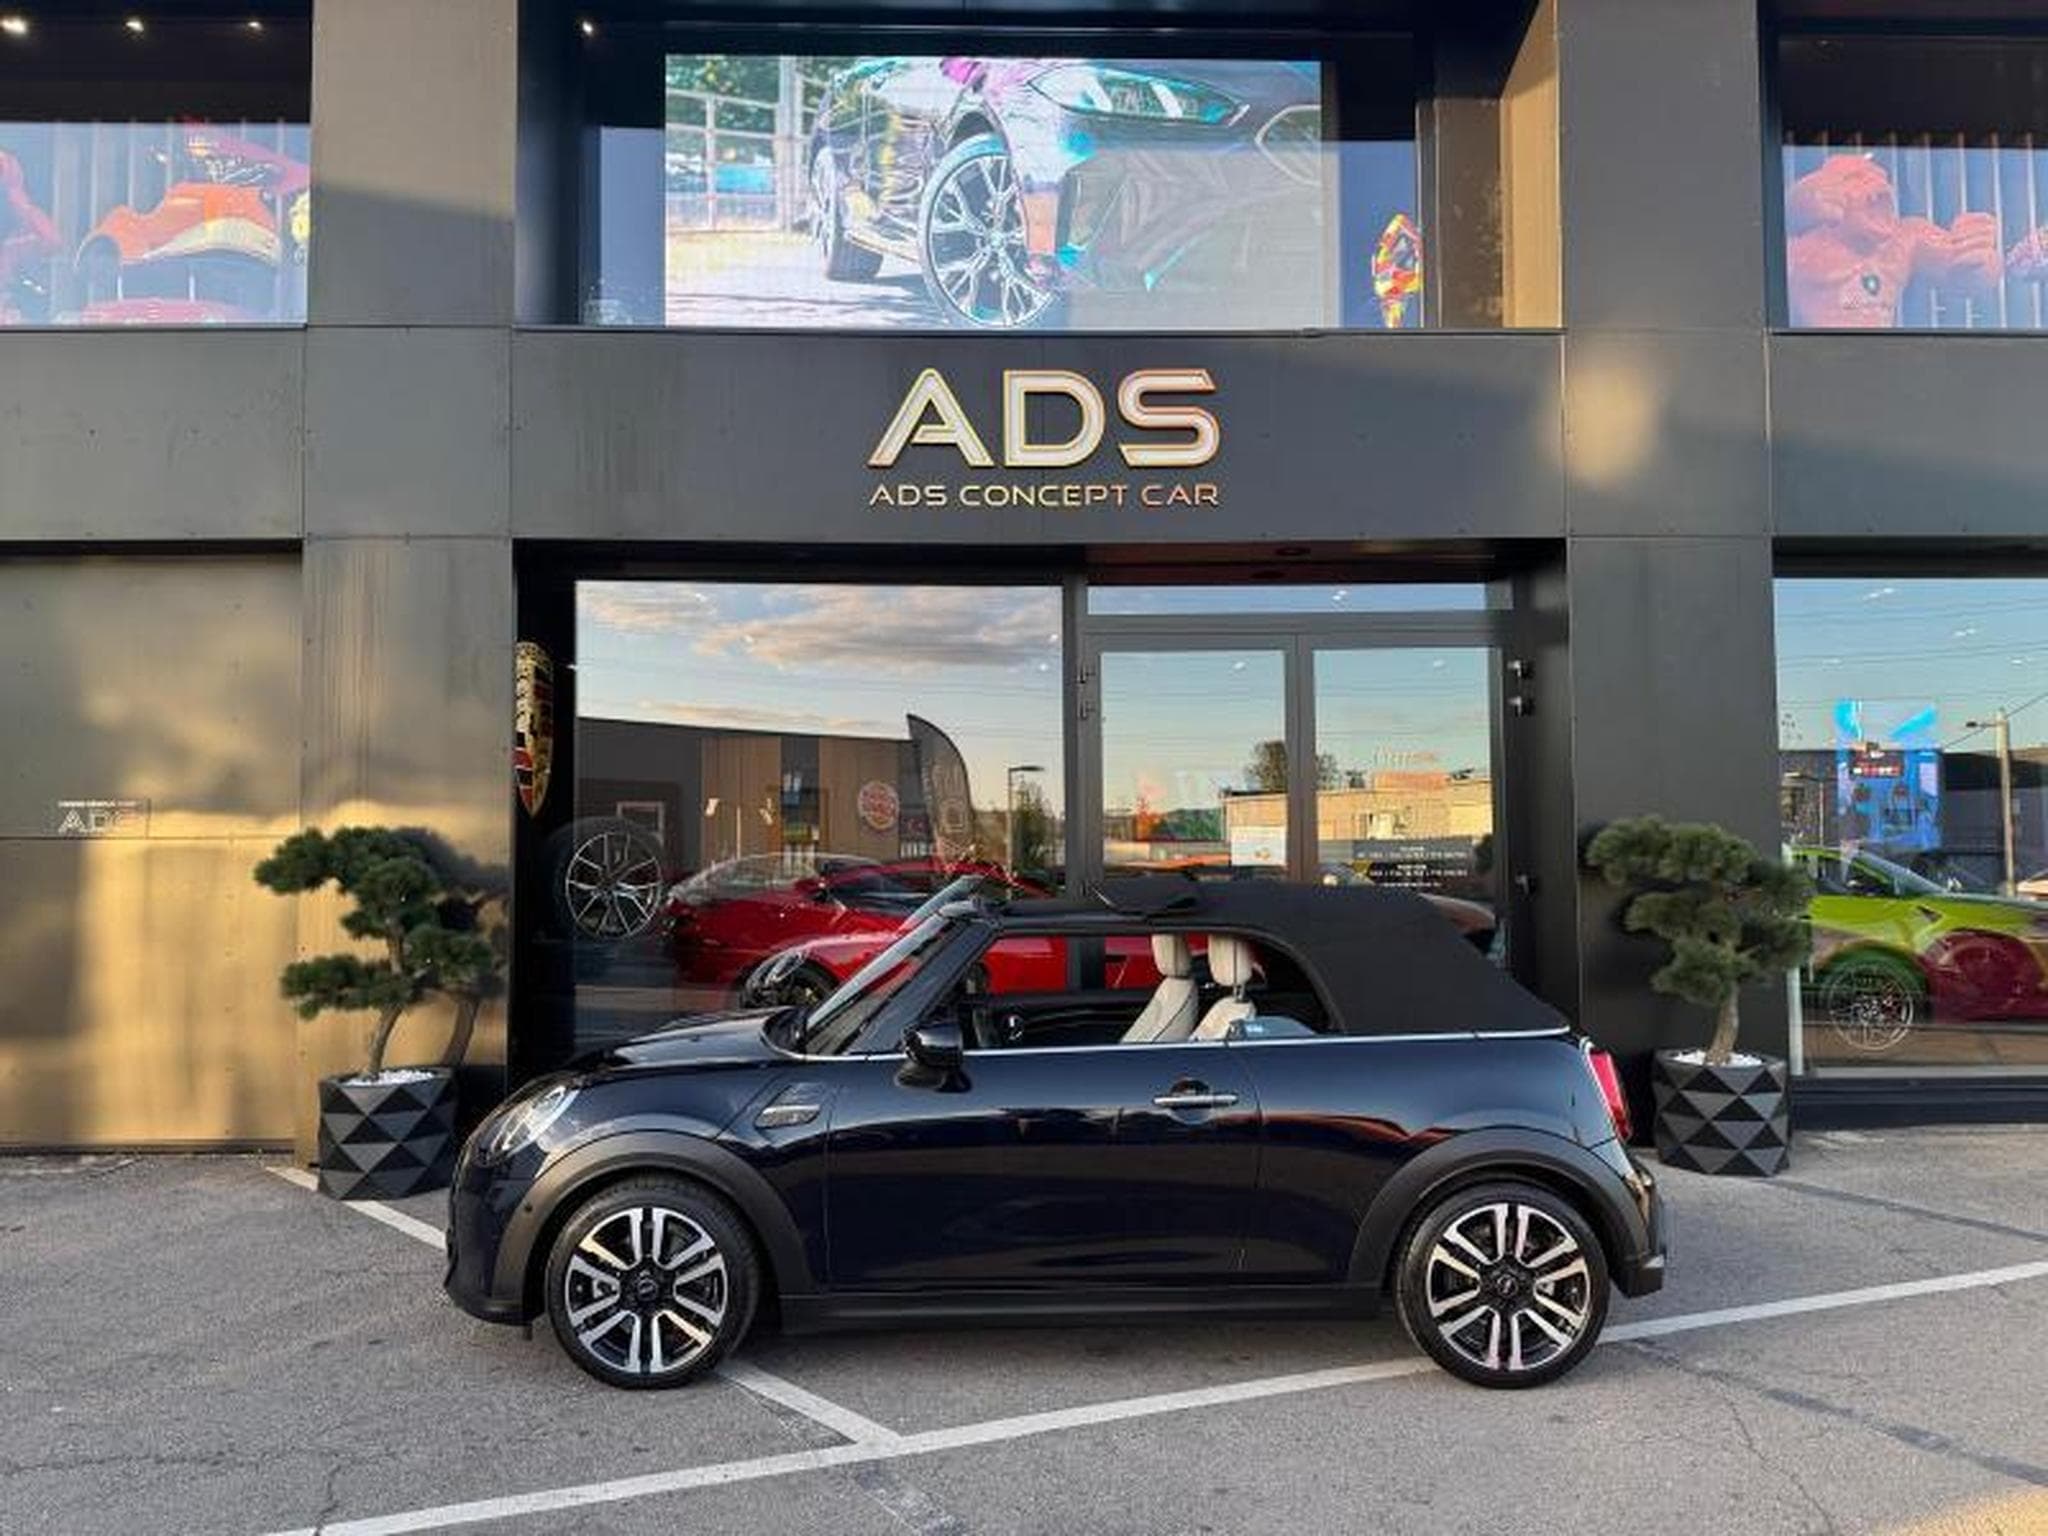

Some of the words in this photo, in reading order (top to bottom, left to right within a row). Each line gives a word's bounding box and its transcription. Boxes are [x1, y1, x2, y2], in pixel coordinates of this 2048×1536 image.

[867, 367, 1221, 468] ADS
[868, 484, 946, 507] ADS
[959, 484, 1128, 507] CONCEPT
[1141, 484, 1220, 507] CAR
